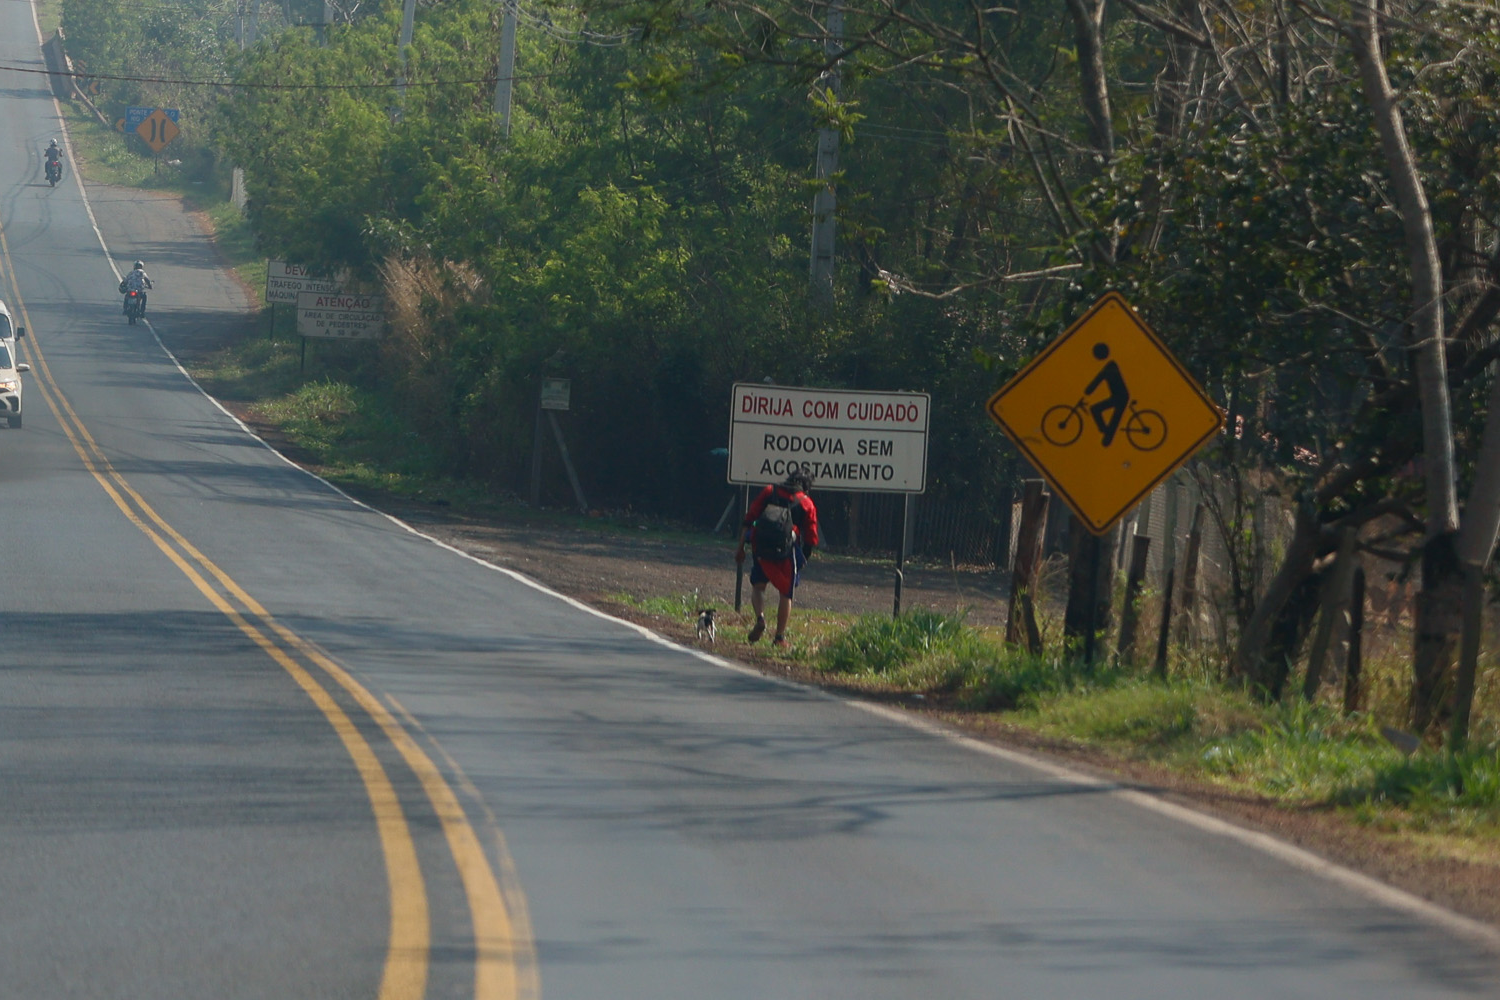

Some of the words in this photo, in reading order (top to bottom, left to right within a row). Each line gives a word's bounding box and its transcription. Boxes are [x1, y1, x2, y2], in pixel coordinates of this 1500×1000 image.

[742, 395, 793, 417] DIRIJA
[802, 400, 839, 419] COM
[847, 402, 919, 422] CUIDADO
[763, 434, 845, 454] RODOVIA
[857, 439, 893, 457] SEM
